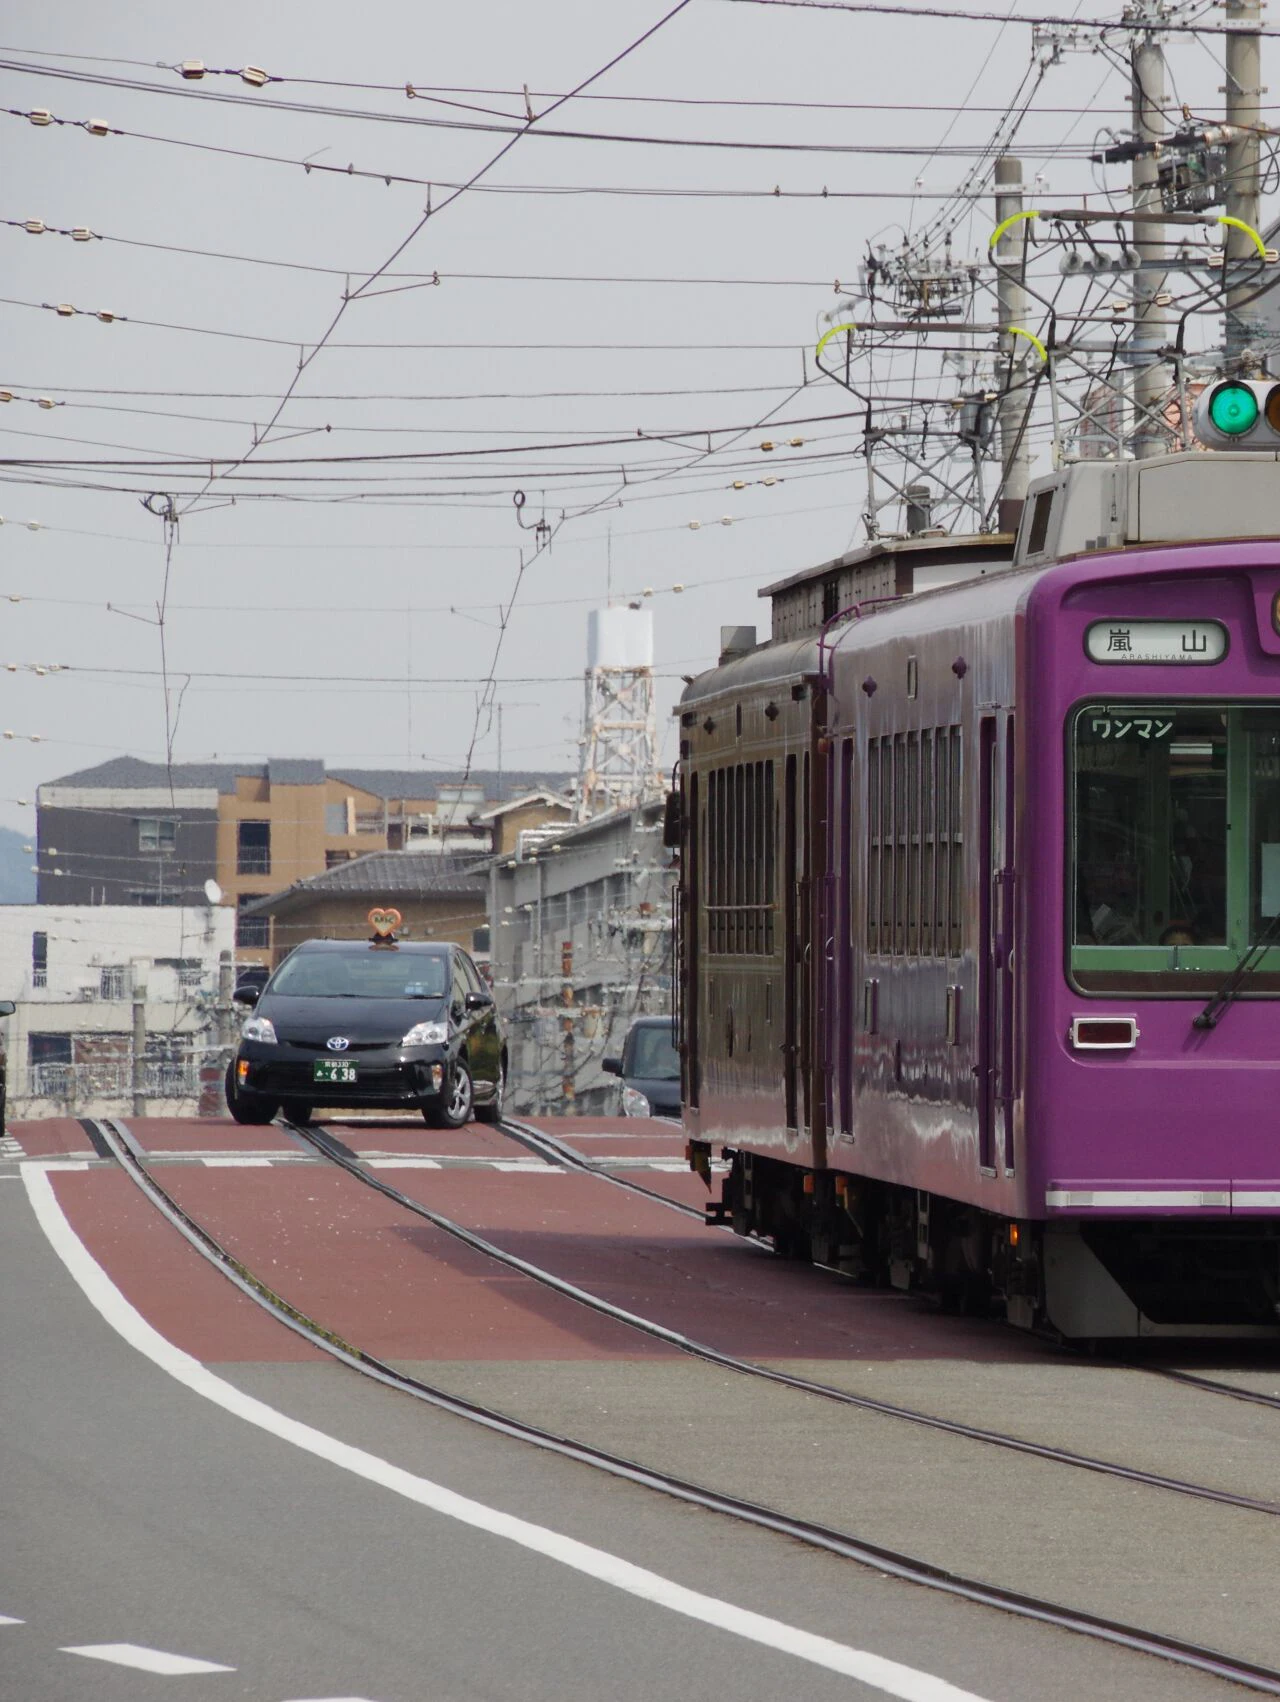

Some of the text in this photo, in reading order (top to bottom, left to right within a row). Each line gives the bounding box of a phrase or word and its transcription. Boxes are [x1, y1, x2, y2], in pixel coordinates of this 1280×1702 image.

[1107, 628, 1207, 652] 嵐山
[1092, 719, 1173, 739] ワンマン
[341, 1068, 356, 1080] 38
